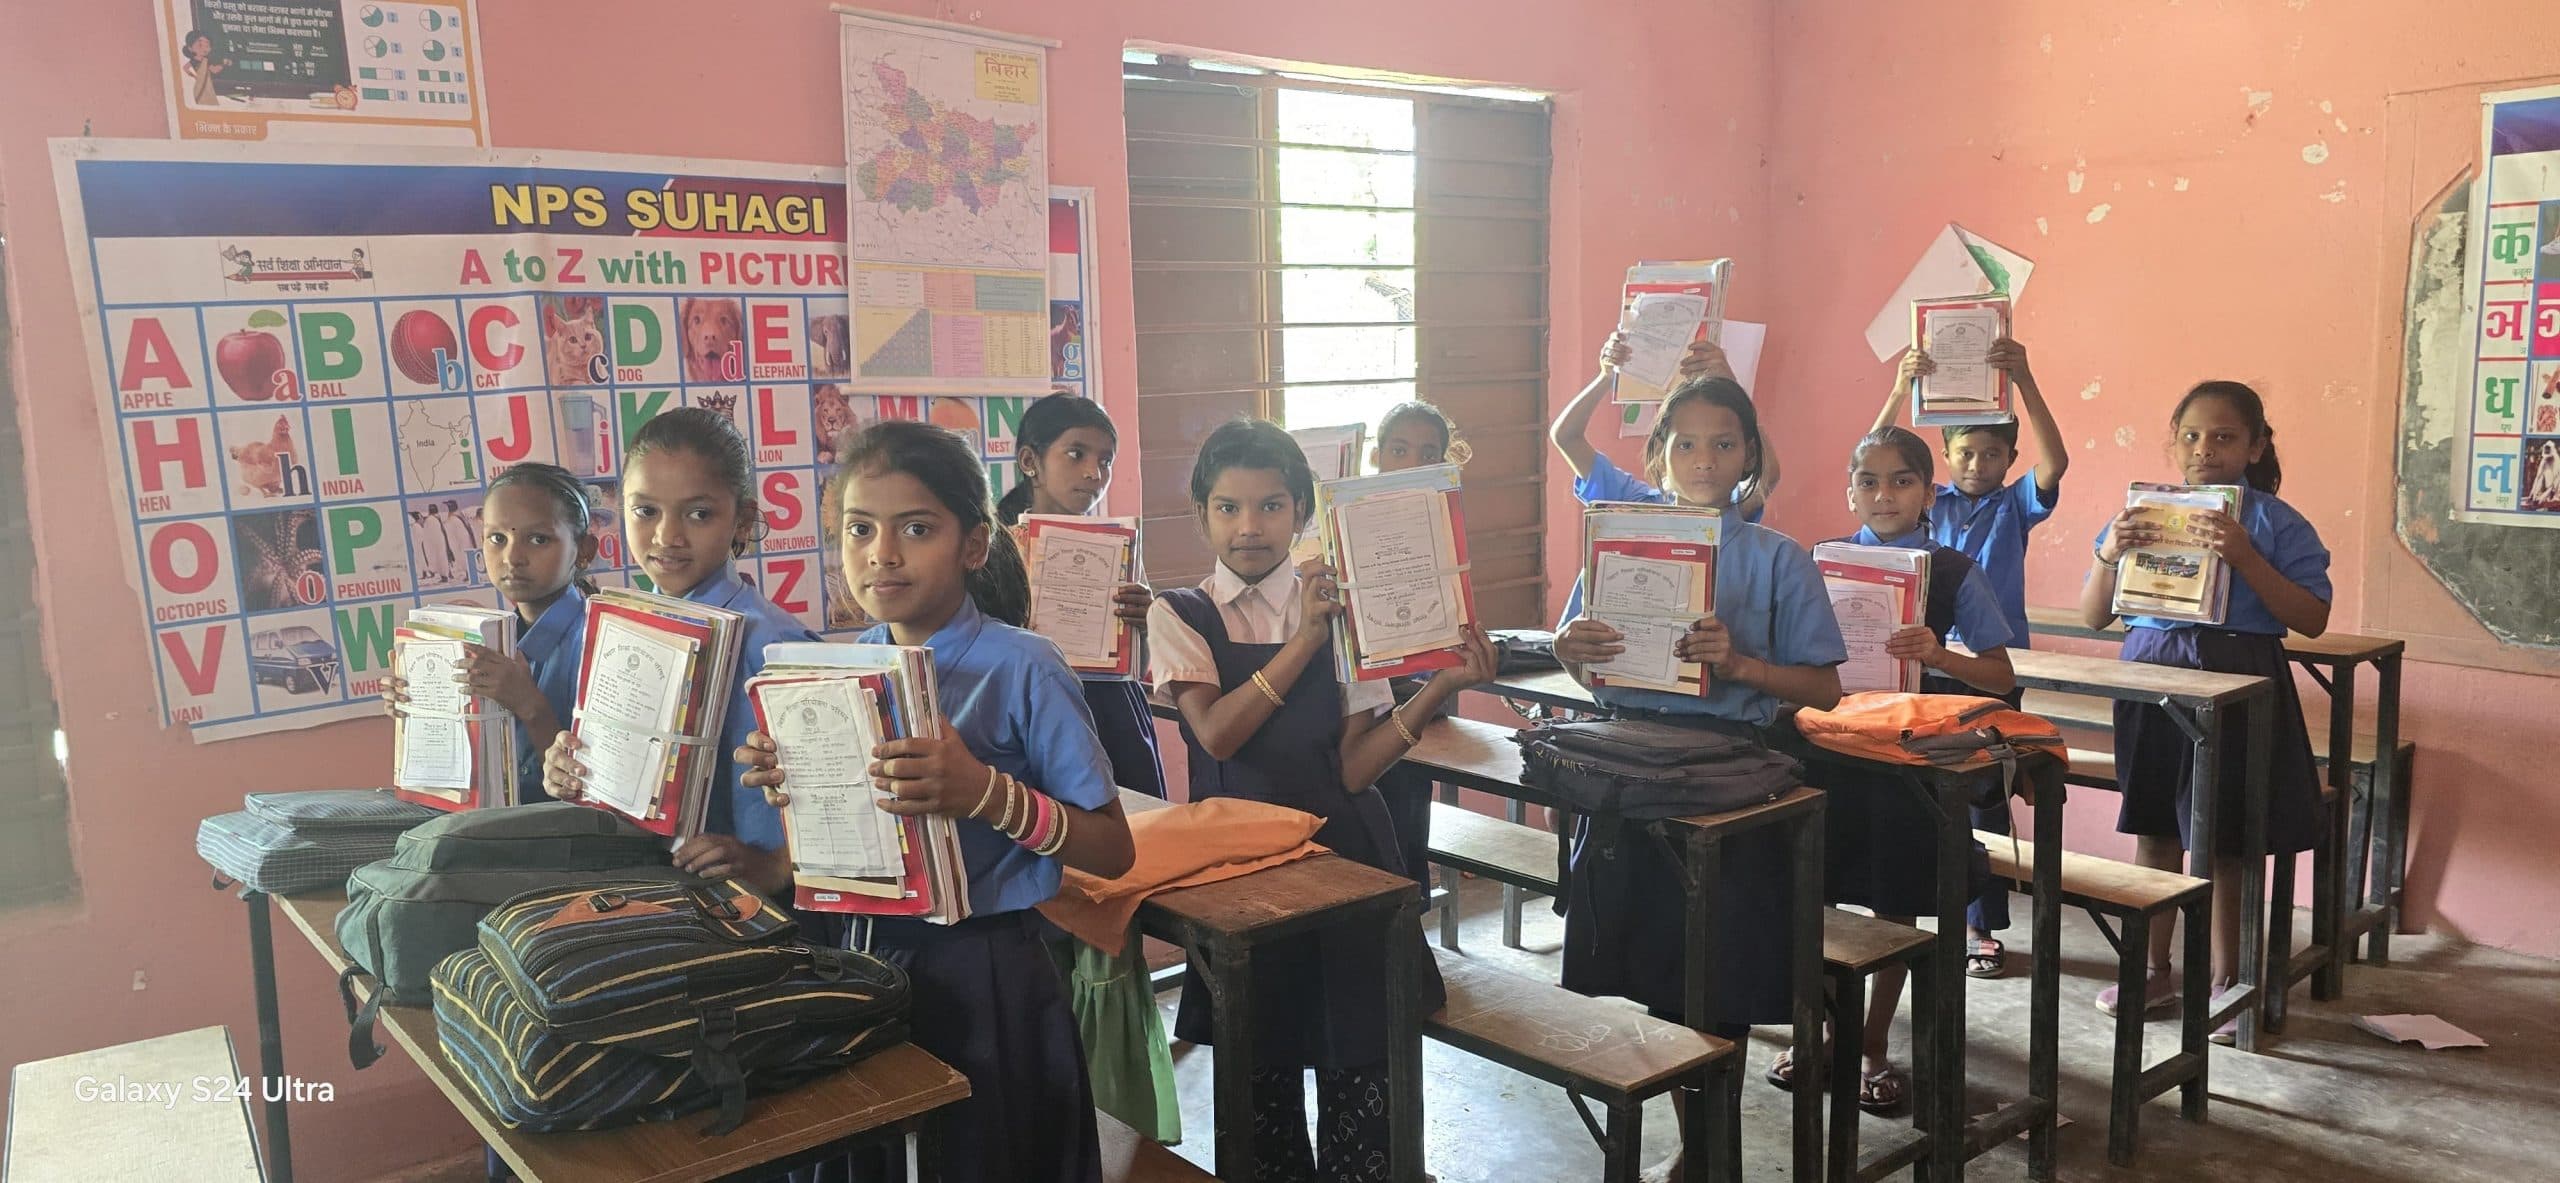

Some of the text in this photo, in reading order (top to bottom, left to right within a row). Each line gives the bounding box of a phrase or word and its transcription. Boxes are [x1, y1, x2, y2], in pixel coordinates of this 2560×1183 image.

[983, 56, 1029, 80] बिहार
[489, 183, 828, 236] NPS SUHAGI
[2491, 221, 2536, 264] क
[256, 256, 343, 272] सर्व शिक्षा अभियान
[459, 248, 492, 286] A
[503, 247, 547, 284] to
[557, 248, 586, 285] Z
[598, 249, 687, 286] with
[468, 304, 525, 372] C
[612, 304, 663, 367] D
[752, 304, 793, 364] E
[2485, 300, 2529, 341] ञ
[119, 317, 193, 392] A
[298, 311, 363, 382] B
[720, 340, 747, 382] d
[271, 368, 303, 401] a
[432, 347, 464, 392] b
[475, 371, 502, 389] CAT
[587, 354, 610, 384] c
[617, 367, 643, 382] DOG
[753, 364, 807, 379] ELEPHANT
[123, 391, 174, 410] APPLE
[309, 382, 347, 399] BALL
[2484, 376, 2520, 418] ध
[486, 394, 532, 462] J
[757, 388, 797, 447] L
[131, 417, 207, 493] H
[331, 407, 359, 476] I
[415, 438, 436, 448] India
[758, 449, 783, 463] LION
[987, 440, 1011, 454] NEST
[275, 451, 312, 498] h
[322, 478, 365, 497] INDIA
[2477, 452, 2518, 494] ल
[138, 495, 171, 513] HEN
[762, 471, 803, 531] S
[149, 521, 219, 595] O
[327, 506, 382, 576] P
[598, 531, 626, 569] q
[763, 534, 817, 552] SUNFLOWER
[337, 577, 401, 599] PENGUIN
[767, 558, 808, 615] Z
[156, 599, 228, 622] OCTOPUS
[335, 603, 395, 673] W
[159, 624, 227, 697] V
[308, 661, 339, 695] v
[350, 679, 385, 697] WHE
[171, 705, 204, 722] VAN
